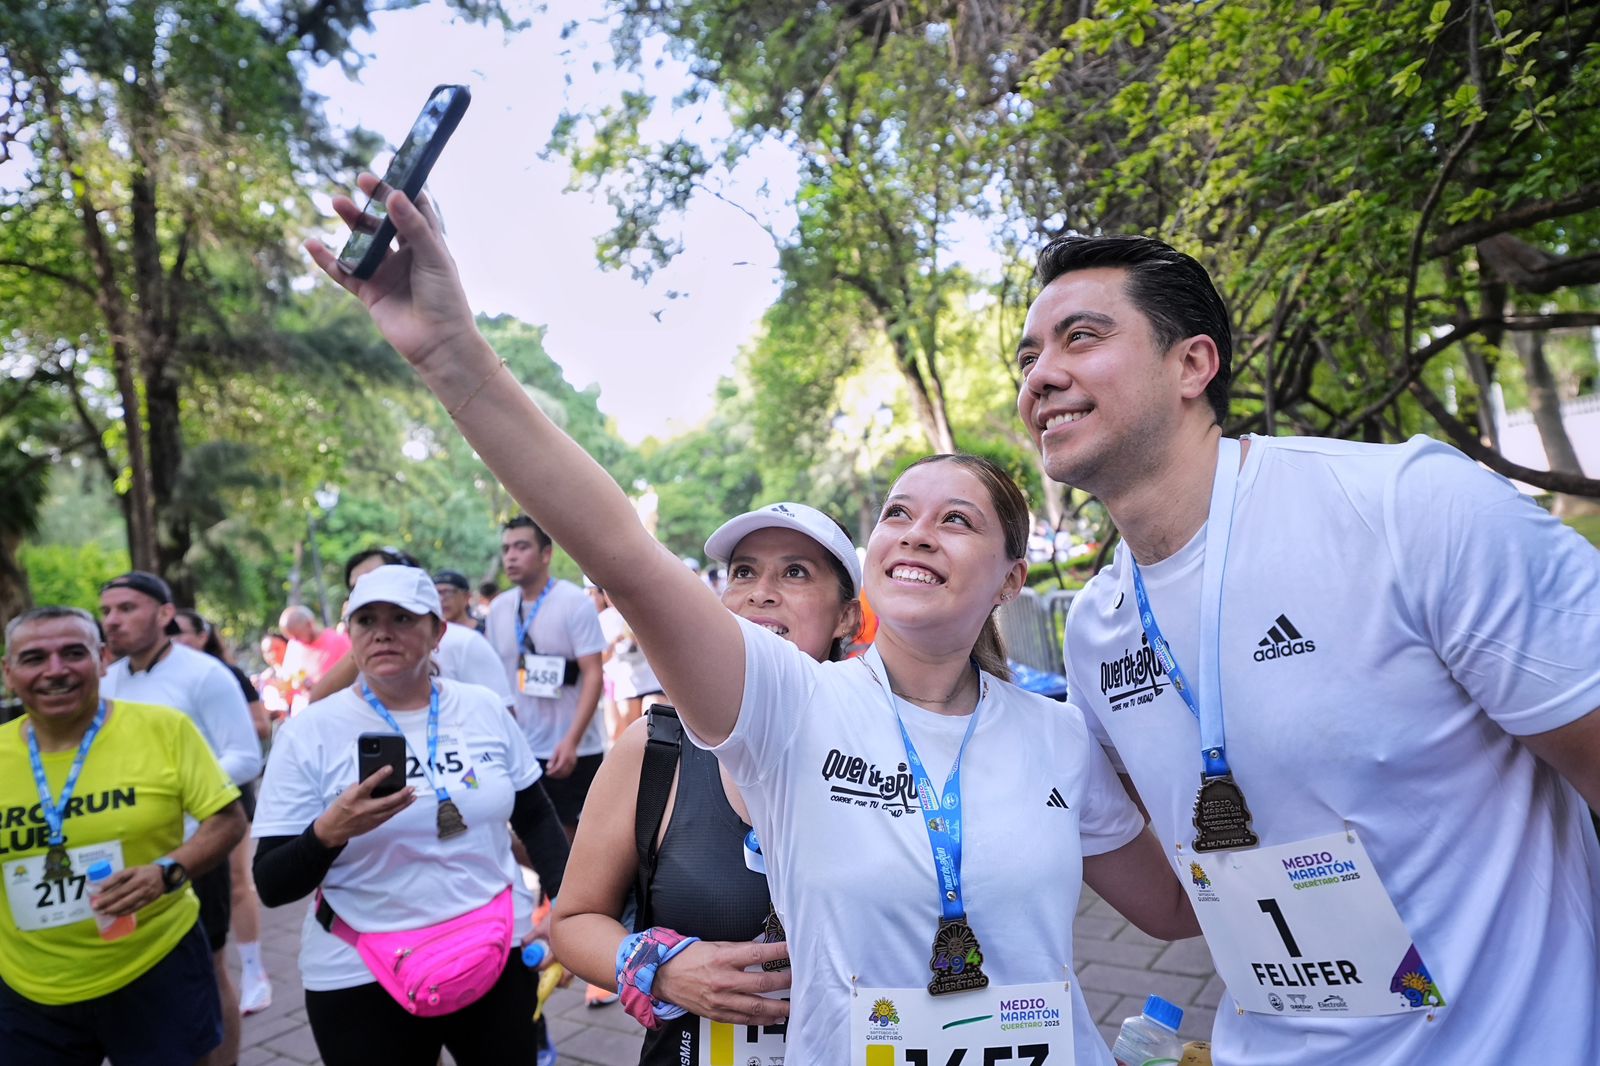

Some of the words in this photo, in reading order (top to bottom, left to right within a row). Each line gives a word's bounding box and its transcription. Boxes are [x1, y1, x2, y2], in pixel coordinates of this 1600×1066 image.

[1253, 640, 1316, 662] adidas
[830, 795, 853, 804] CORRE
[854, 800, 868, 808] POR
[869, 800, 879, 808] TU
[1201, 799, 1232, 808] MEDIO
[1281, 851, 1333, 870] MEDIO
[1287, 860, 1356, 881] MARATÓN
[1292, 877, 1340, 890] QUERÉTARO
[1341, 872, 1361, 882] 2025
[1257, 898, 1302, 957] 1
[1251, 960, 1363, 986] FELIFER
[931, 977, 987, 992] QUERÉTARO
[1000, 998, 1045, 1011] MEDIO
[1000, 1007, 1059, 1022] MARATÓN
[1000, 1021, 1043, 1031] QUERÉTARO
[680, 1030, 692, 1066] SMAS
